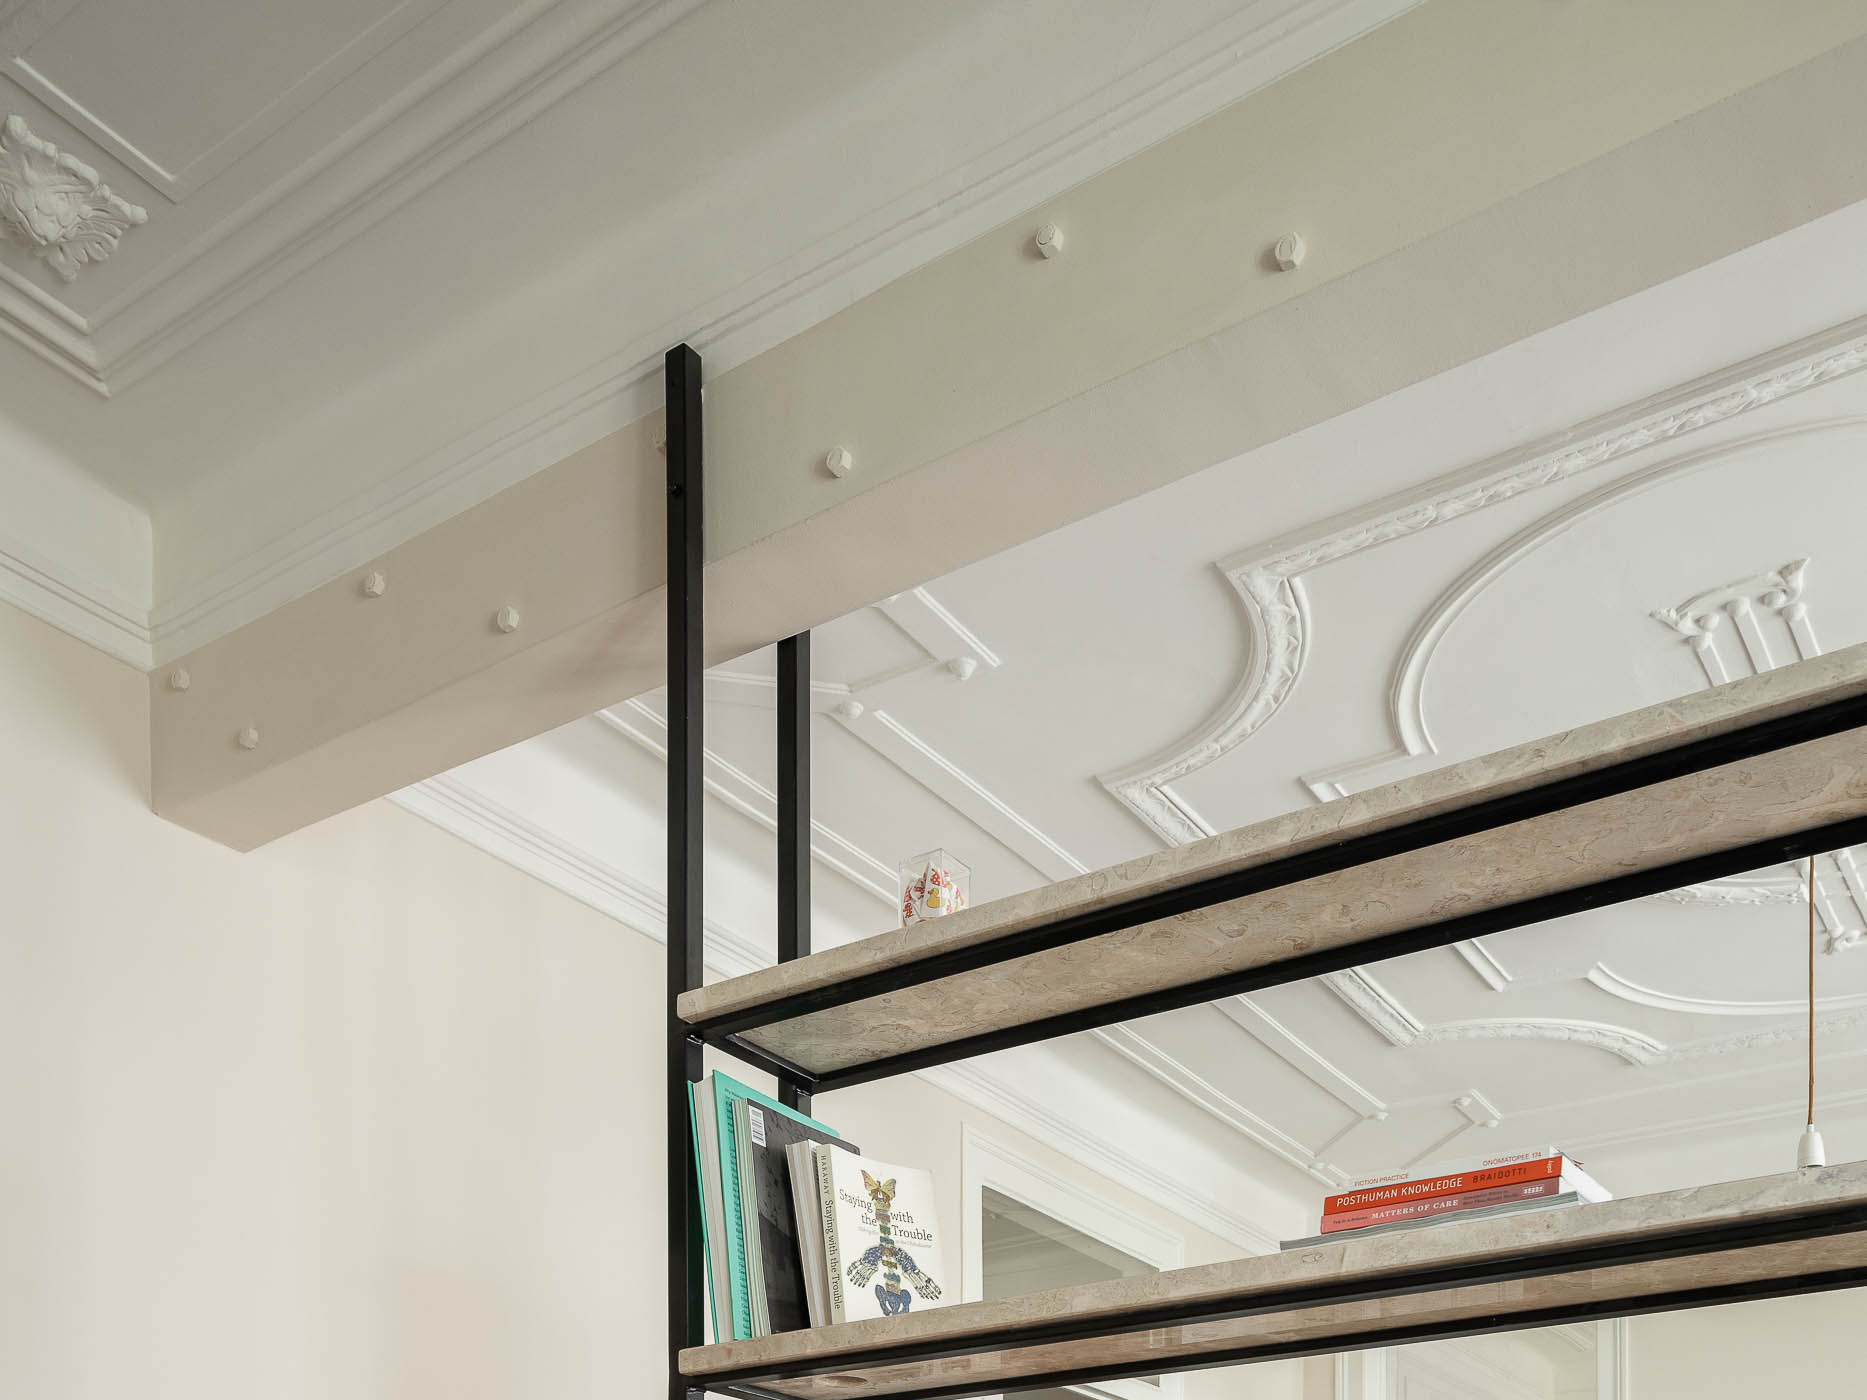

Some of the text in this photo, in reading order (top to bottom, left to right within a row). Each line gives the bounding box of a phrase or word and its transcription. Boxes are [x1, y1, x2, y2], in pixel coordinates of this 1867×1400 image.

[1482, 1153, 1529, 1166] ONOMATOPEE
[821, 1155, 829, 1194] HARAWAY
[1354, 1173, 1409, 1187] FICTION PRACTICE
[1472, 1167, 1527, 1184] BRAIDOTTI
[840, 1189, 914, 1224] Staying with
[1336, 1177, 1463, 1208] POSTHUMAN KNOWLEDGE
[1371, 1199, 1459, 1219] MATTERS OF CARE
[861, 1213, 877, 1227] the
[891, 1224, 933, 1242] Trouble
[825, 1200, 844, 1310] Staying with the Trouble
